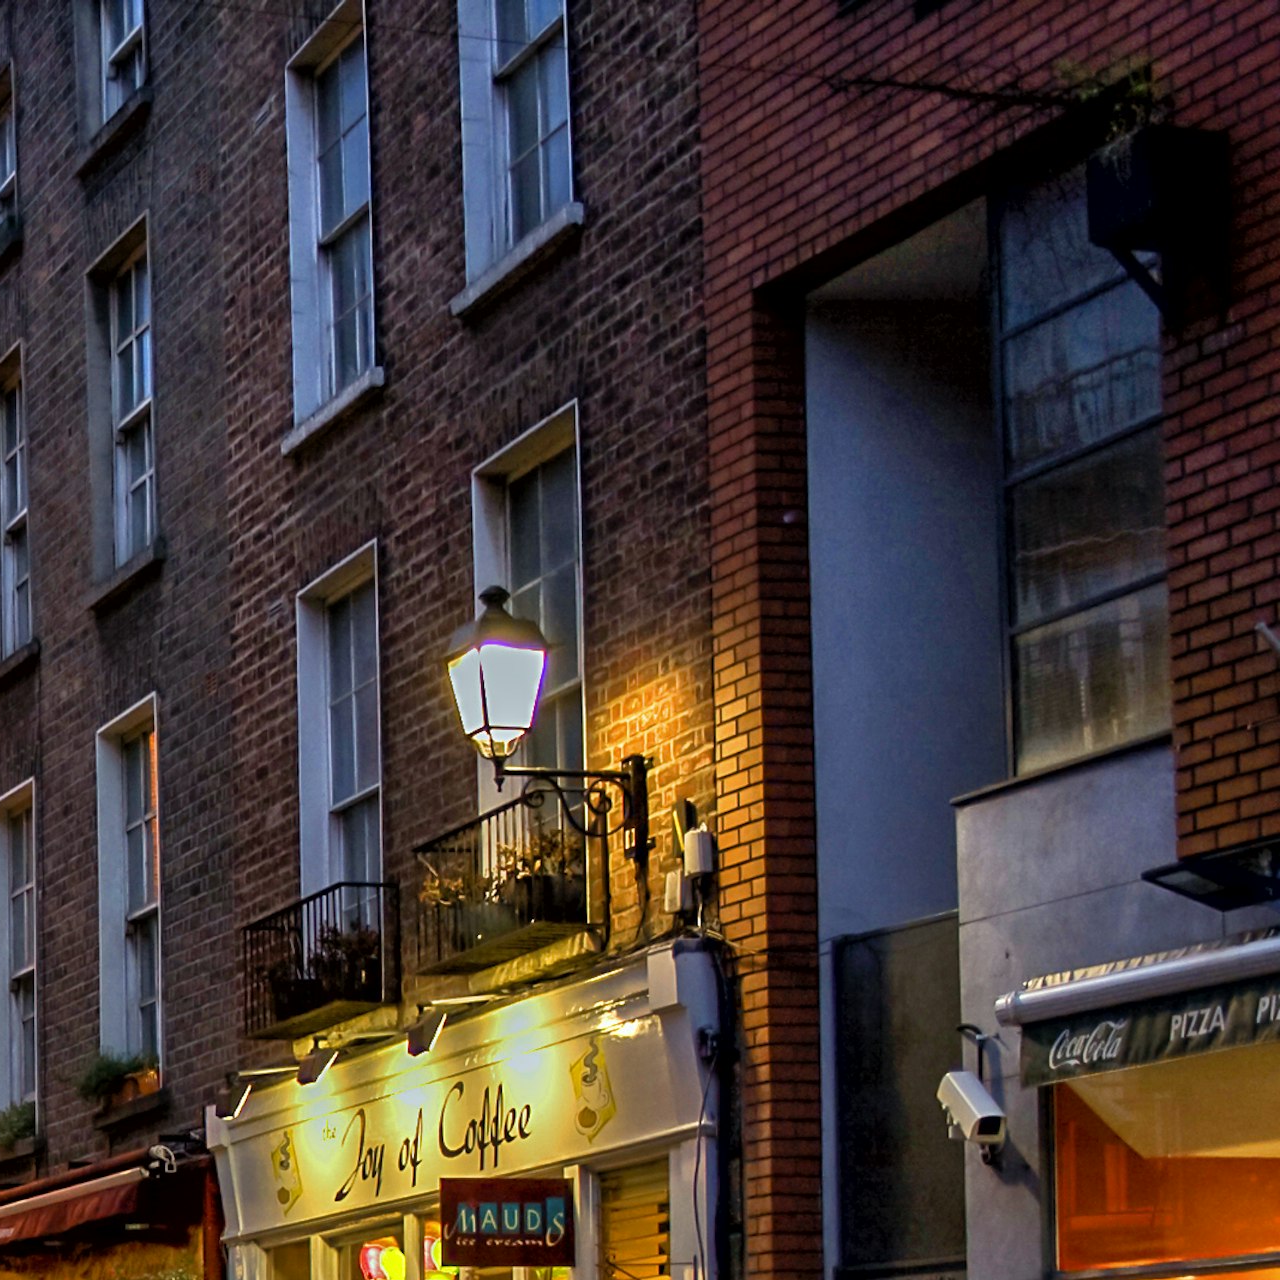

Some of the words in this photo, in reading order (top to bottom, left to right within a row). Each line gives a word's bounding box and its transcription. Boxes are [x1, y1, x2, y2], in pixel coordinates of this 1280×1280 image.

[1170, 1005, 1226, 1042] PIZZA
[334, 1108, 385, 1202] Joy
[398, 1107, 423, 1188] of
[438, 1081, 533, 1171] Coffee
[444, 1207, 565, 1247] MAUDS
[456, 1237, 476, 1246] ice
[486, 1238, 543, 1246] cream
